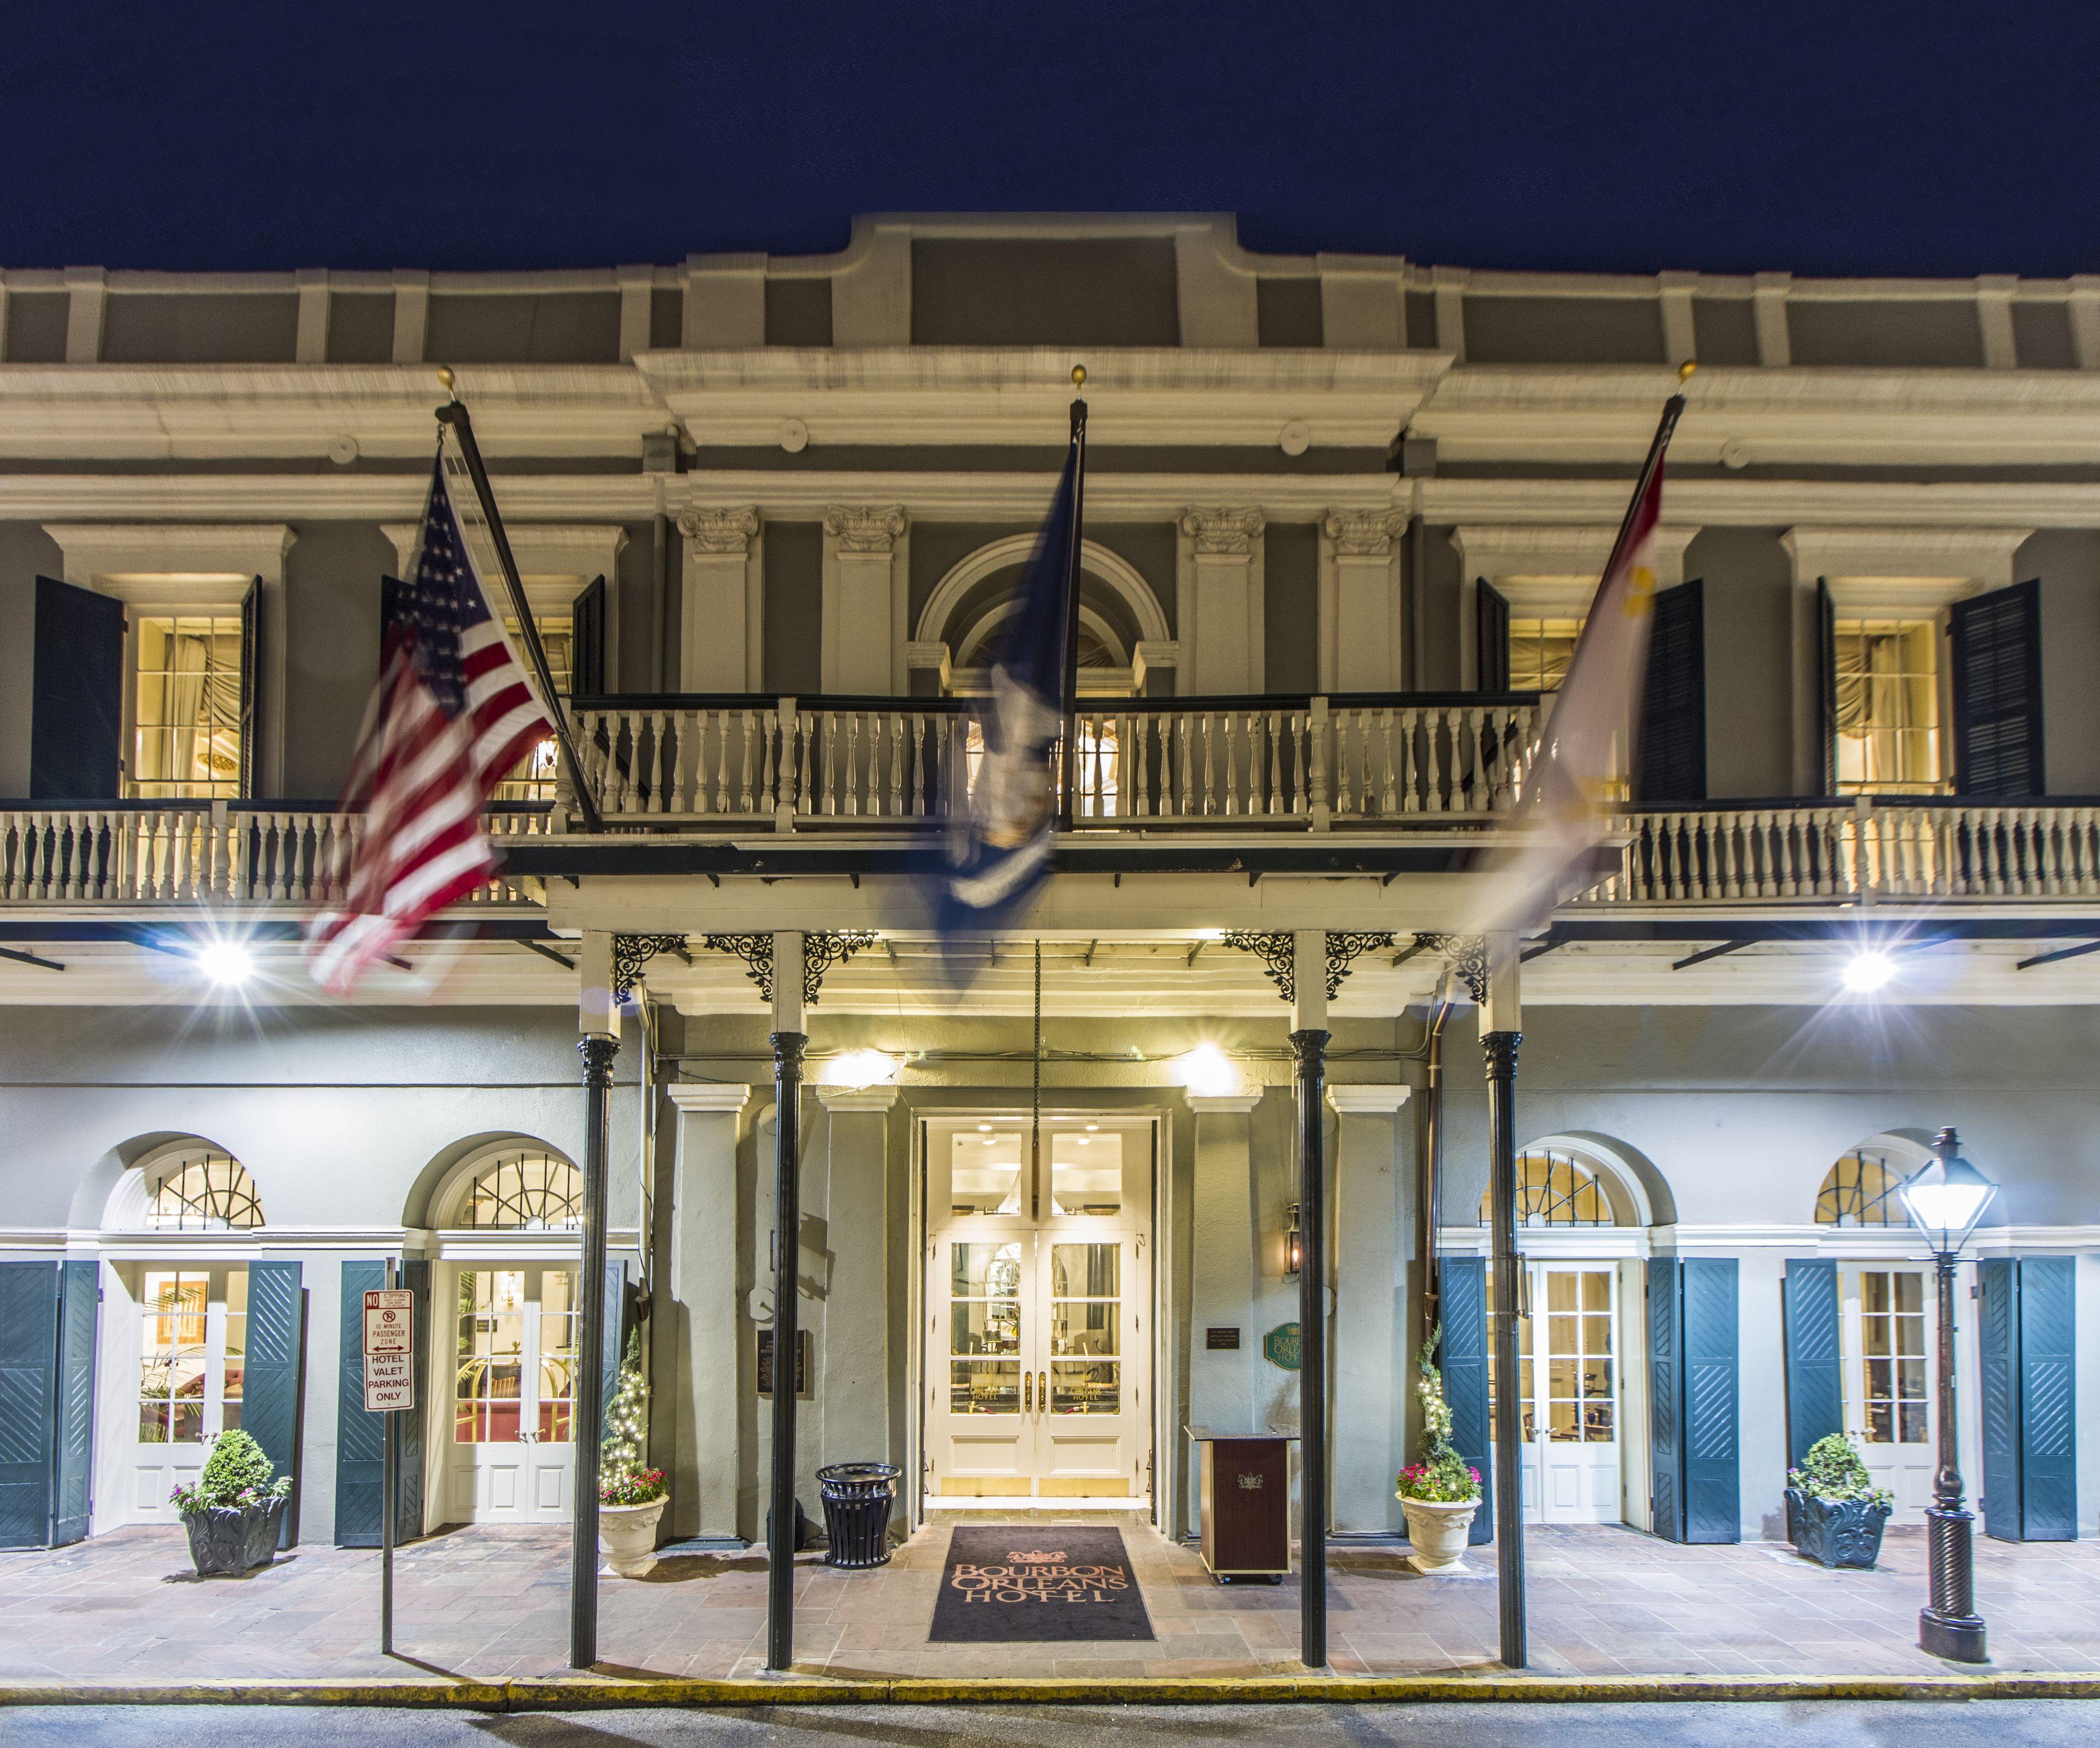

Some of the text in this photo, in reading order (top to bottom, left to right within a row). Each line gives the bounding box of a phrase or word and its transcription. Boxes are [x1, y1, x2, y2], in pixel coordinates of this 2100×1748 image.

[367, 1294, 378, 1306] NO
[1274, 1336, 1300, 1344] BOURB
[1274, 1344, 1300, 1354] ORLE
[372, 1355, 404, 1364] HOTEL
[374, 1367, 403, 1376] VALET
[369, 1379, 409, 1389] PARKING
[376, 1392, 401, 1401] ONLY
[954, 1564, 1124, 1576] BOURBON
[951, 1577, 1129, 1591] ORLEANS
[964, 1590, 1116, 1603] HOTEL
